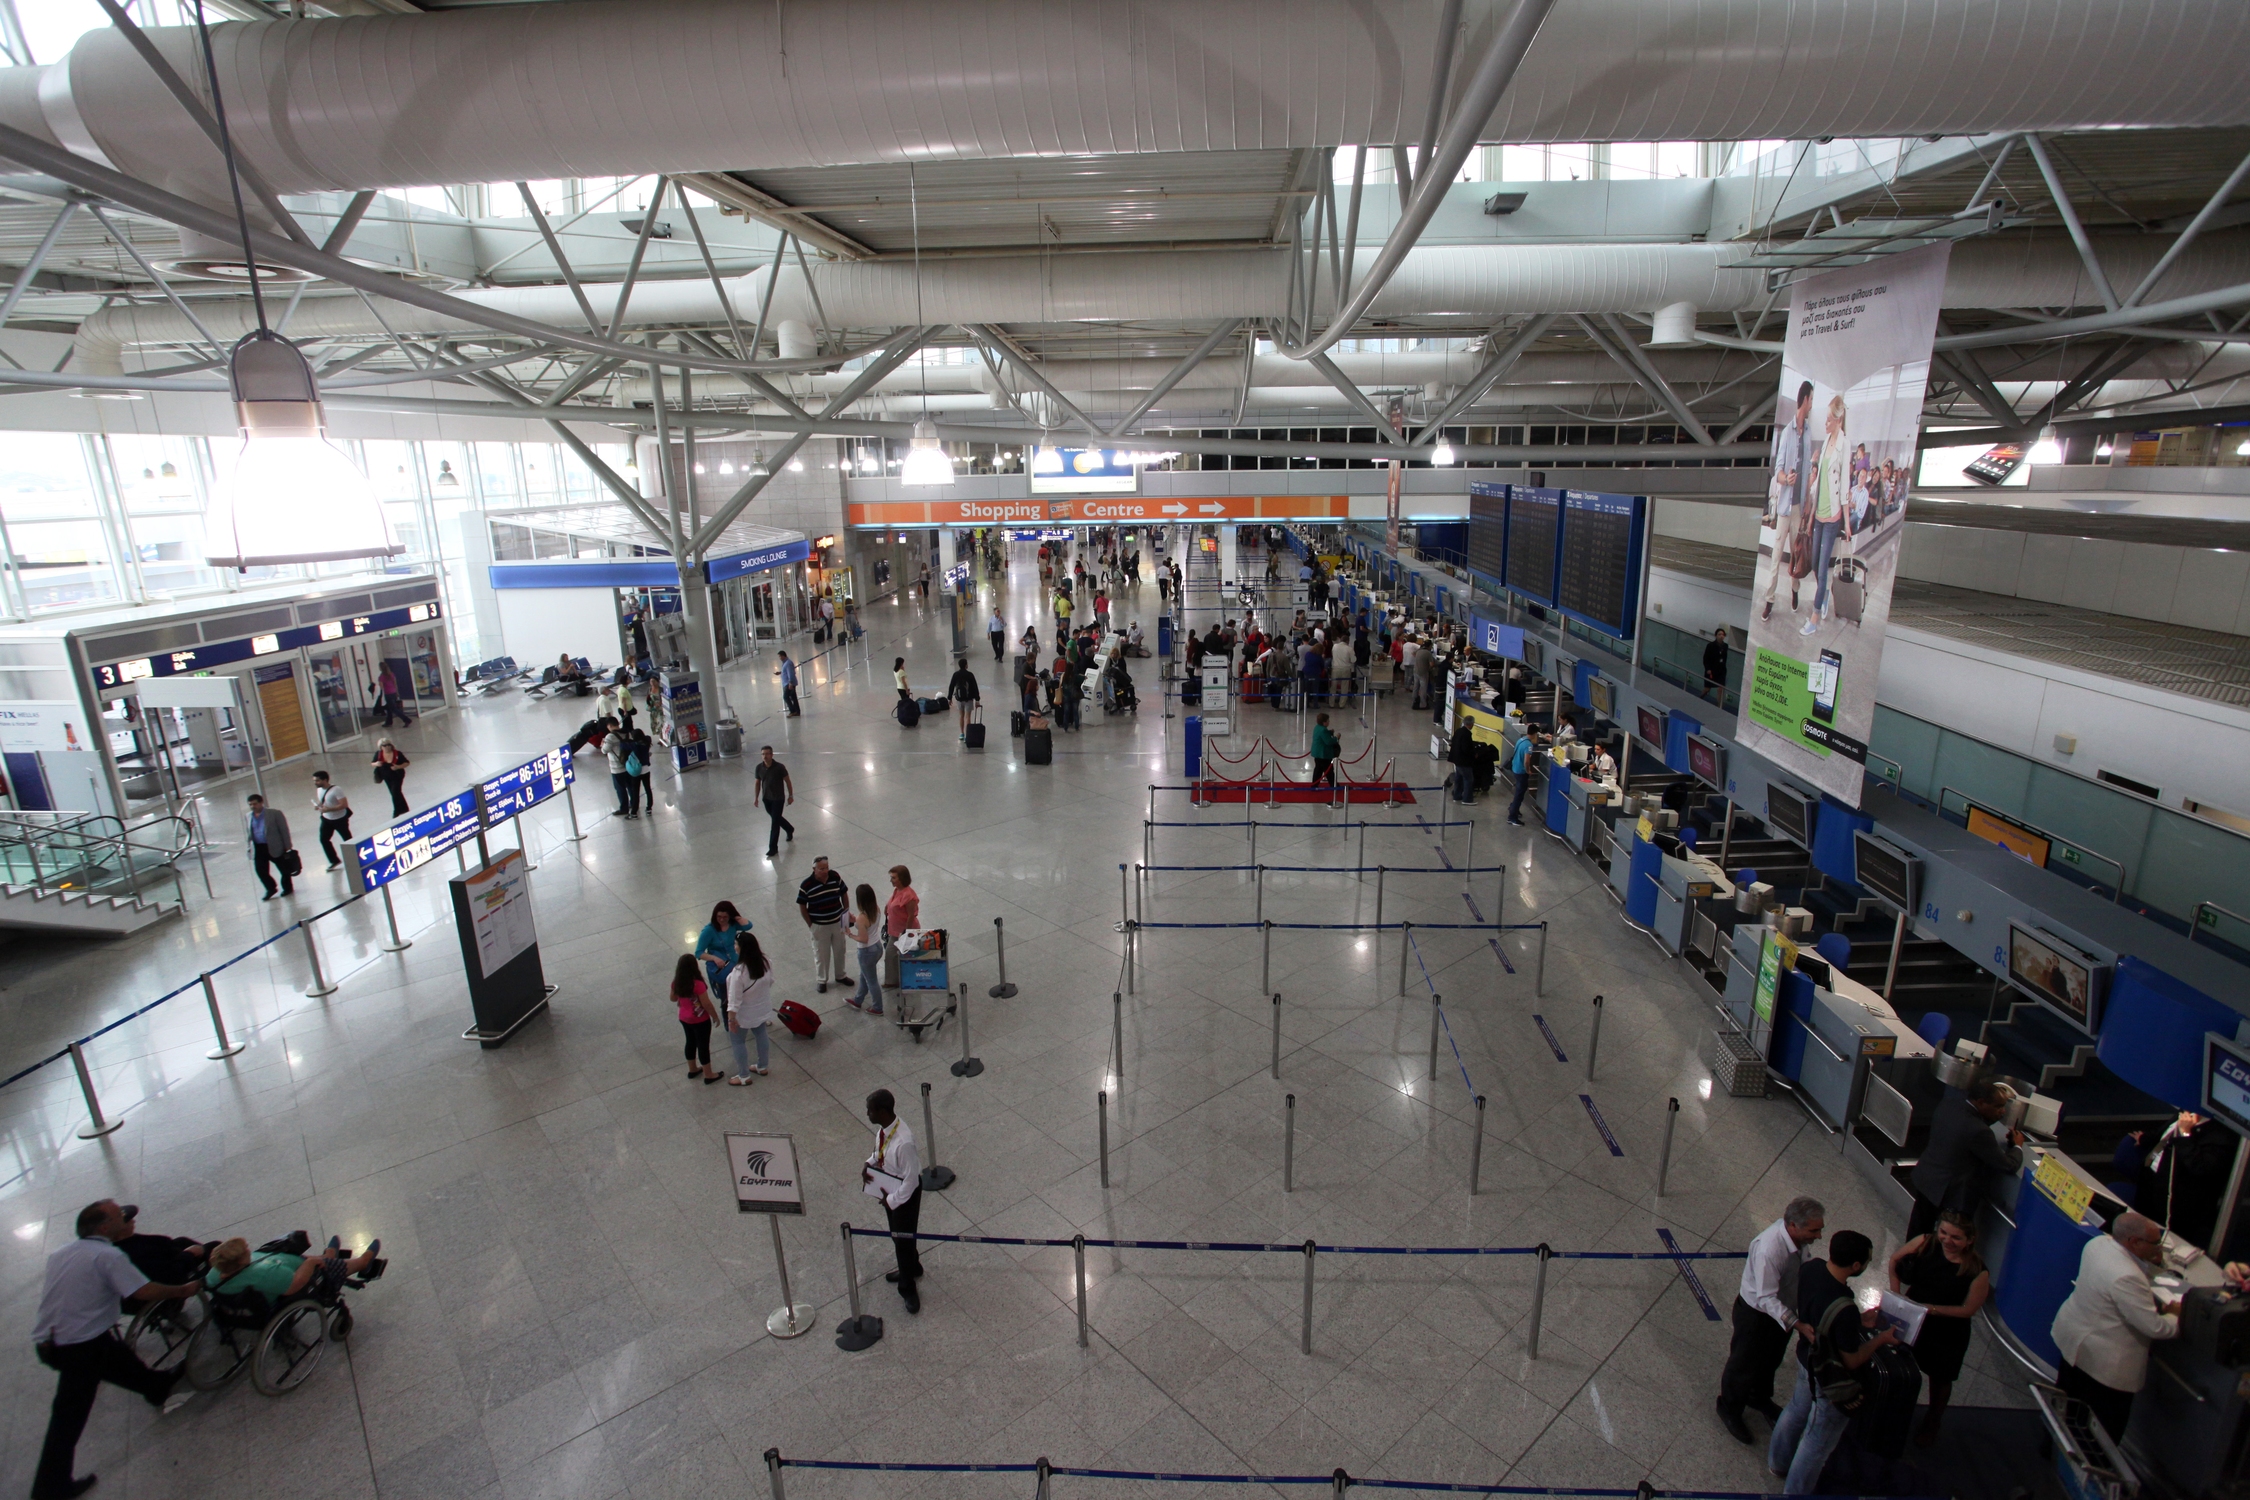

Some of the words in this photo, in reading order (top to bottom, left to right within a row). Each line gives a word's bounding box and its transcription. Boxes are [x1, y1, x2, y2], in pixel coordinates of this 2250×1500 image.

[1804, 301, 1817, 312] Πάρε
[1819, 297, 1835, 309] όλους
[1837, 295, 1850, 304] τους
[1851, 289, 1872, 303] φίλους
[1874, 286, 1887, 295] σου
[1802, 313, 1813, 326] μαζί
[1826, 305, 1852, 320] διακοπές
[1853, 305, 1866, 314] σου
[1816, 322, 1832, 335] Travel
[1833, 320, 1839, 331] &
[1841, 318, 1856, 330] Surf!
[960, 502, 1041, 520] Shopping
[1083, 502, 1145, 516] Centre
[741, 555, 766, 569] SMOKING
[767, 550, 787, 563] LOUNGE
[430, 604, 437, 617] 3
[101, 667, 115, 684] 3
[1788, 664, 1808, 680] Internet
[1754, 686, 1765, 696] μόνο
[1766, 691, 1774, 700] από
[1804, 724, 1828, 740] COSMOTE
[519, 757, 548, 784] 86-157
[485, 789, 501, 801] Check-in
[1728, 779, 1736, 794] 86
[516, 792, 526, 809] A,
[526, 786, 534, 803] B
[438, 798, 462, 823] 1-85
[495, 810, 506, 820] Gates
[395, 832, 416, 846] Check-in
[1925, 903, 1940, 923] 84
[740, 1176, 793, 1187] EGYPTAIR
